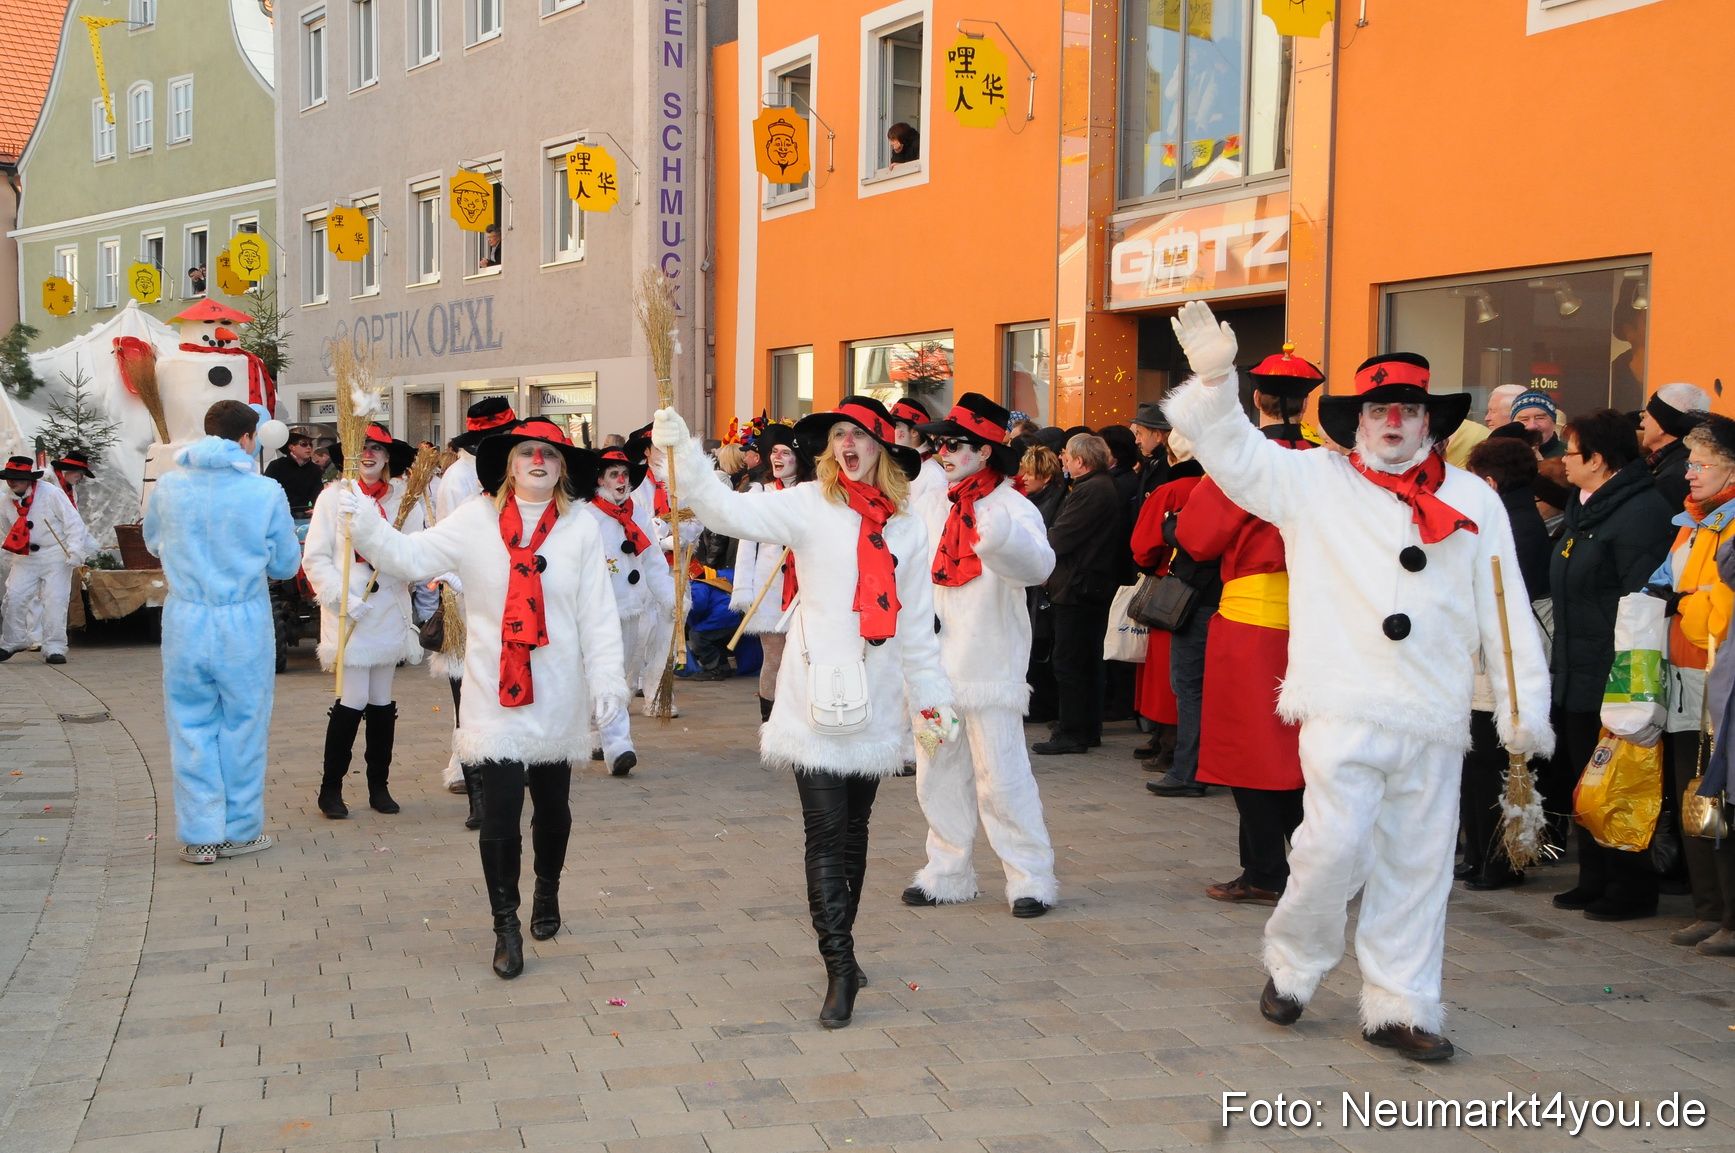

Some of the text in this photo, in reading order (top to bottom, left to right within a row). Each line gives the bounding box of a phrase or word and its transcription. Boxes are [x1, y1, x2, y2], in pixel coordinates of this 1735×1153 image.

[664, 0, 683, 68] EN
[1111, 214, 1290, 286] GÖTZ
[353, 295, 503, 363] OPTIK OEXL
[1540, 377, 1558, 389] One
